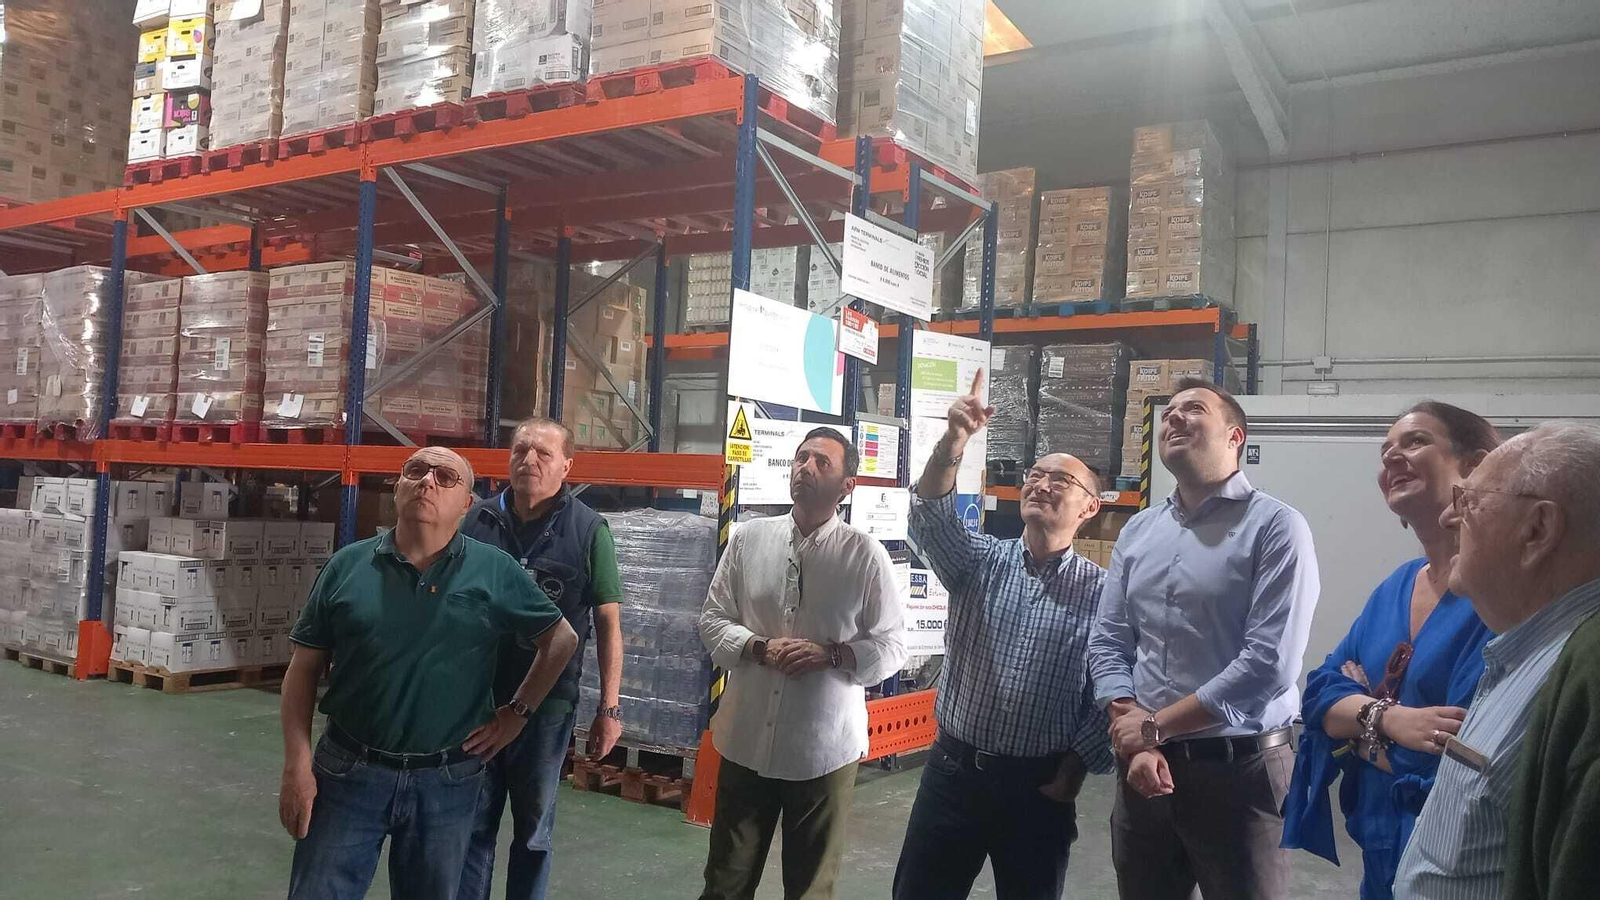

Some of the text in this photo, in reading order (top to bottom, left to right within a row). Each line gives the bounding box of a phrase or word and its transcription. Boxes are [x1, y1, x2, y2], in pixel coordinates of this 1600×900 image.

[1169, 273, 1189, 281] KOIPE
[1137, 374, 1160, 382] FRITOS
[754, 429, 785, 437] TERMINALS
[768, 458, 786, 466] BANCO
[911, 574, 927, 583] ESBA
[916, 619, 942, 629] 15.000
